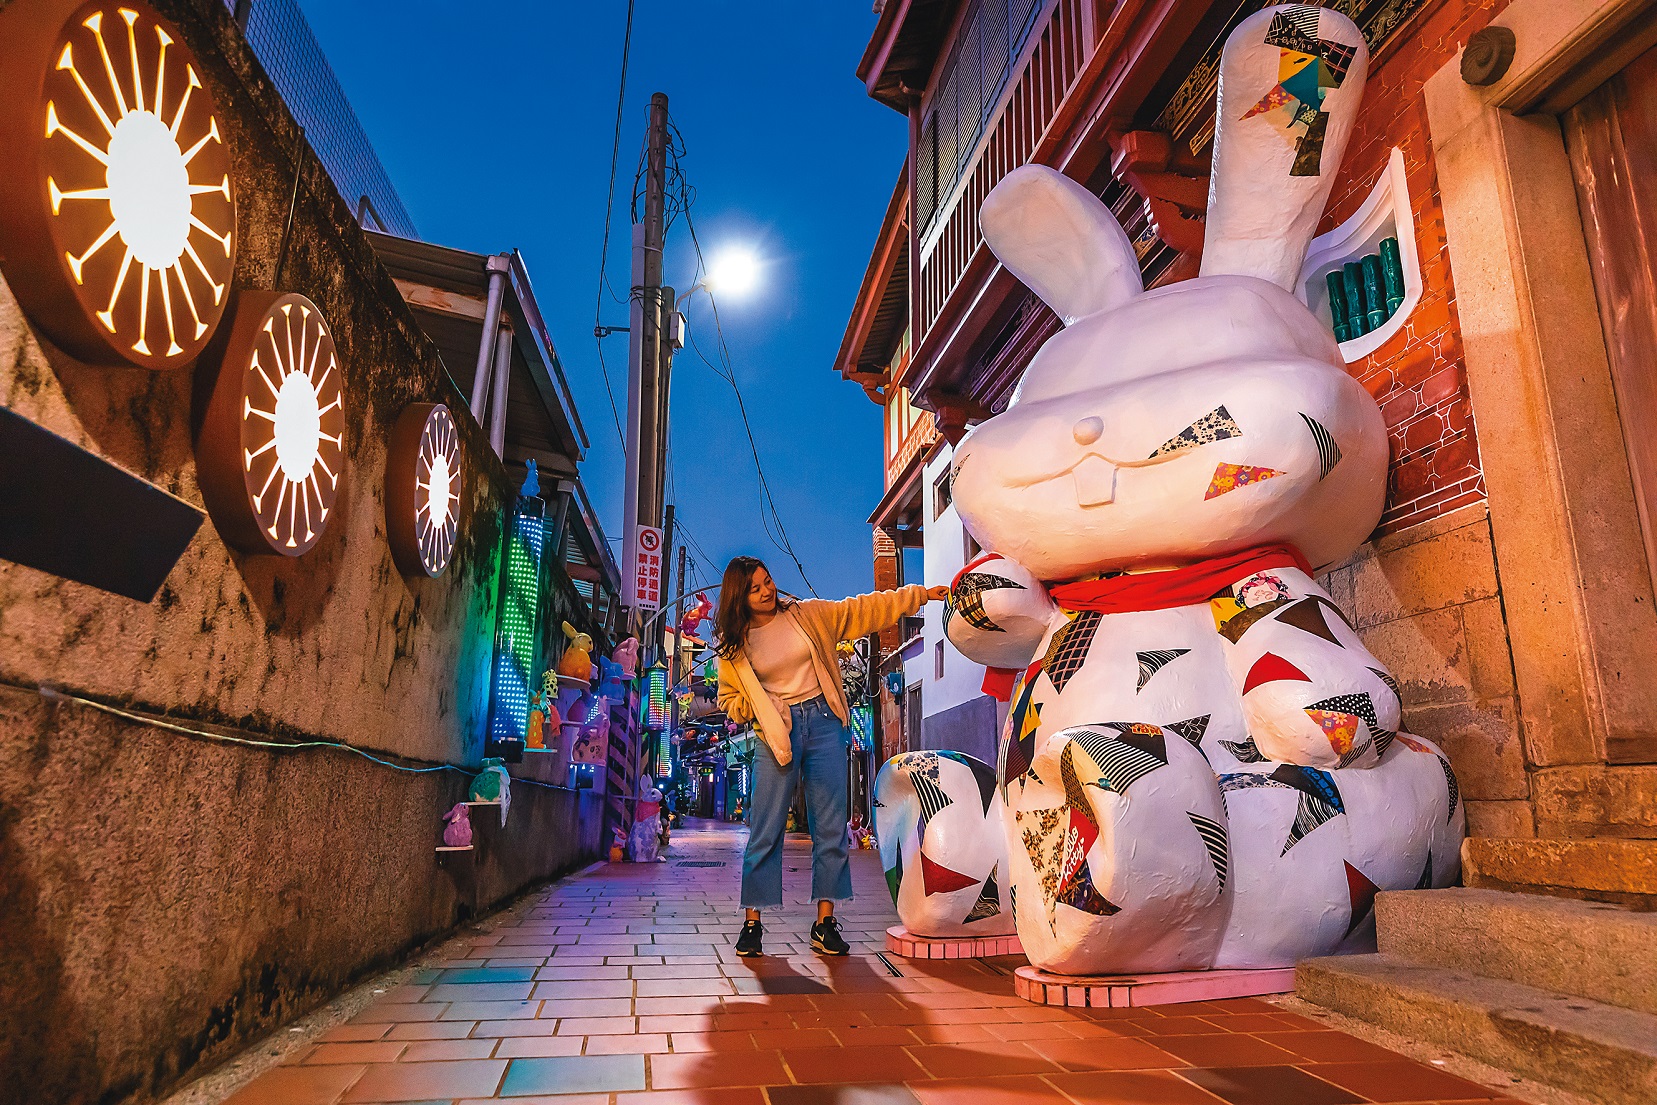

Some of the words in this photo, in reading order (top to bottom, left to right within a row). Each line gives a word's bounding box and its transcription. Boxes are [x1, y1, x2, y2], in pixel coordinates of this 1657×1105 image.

[637, 553, 648, 600] 禁止停車
[648, 555, 659, 602] 消防通道
